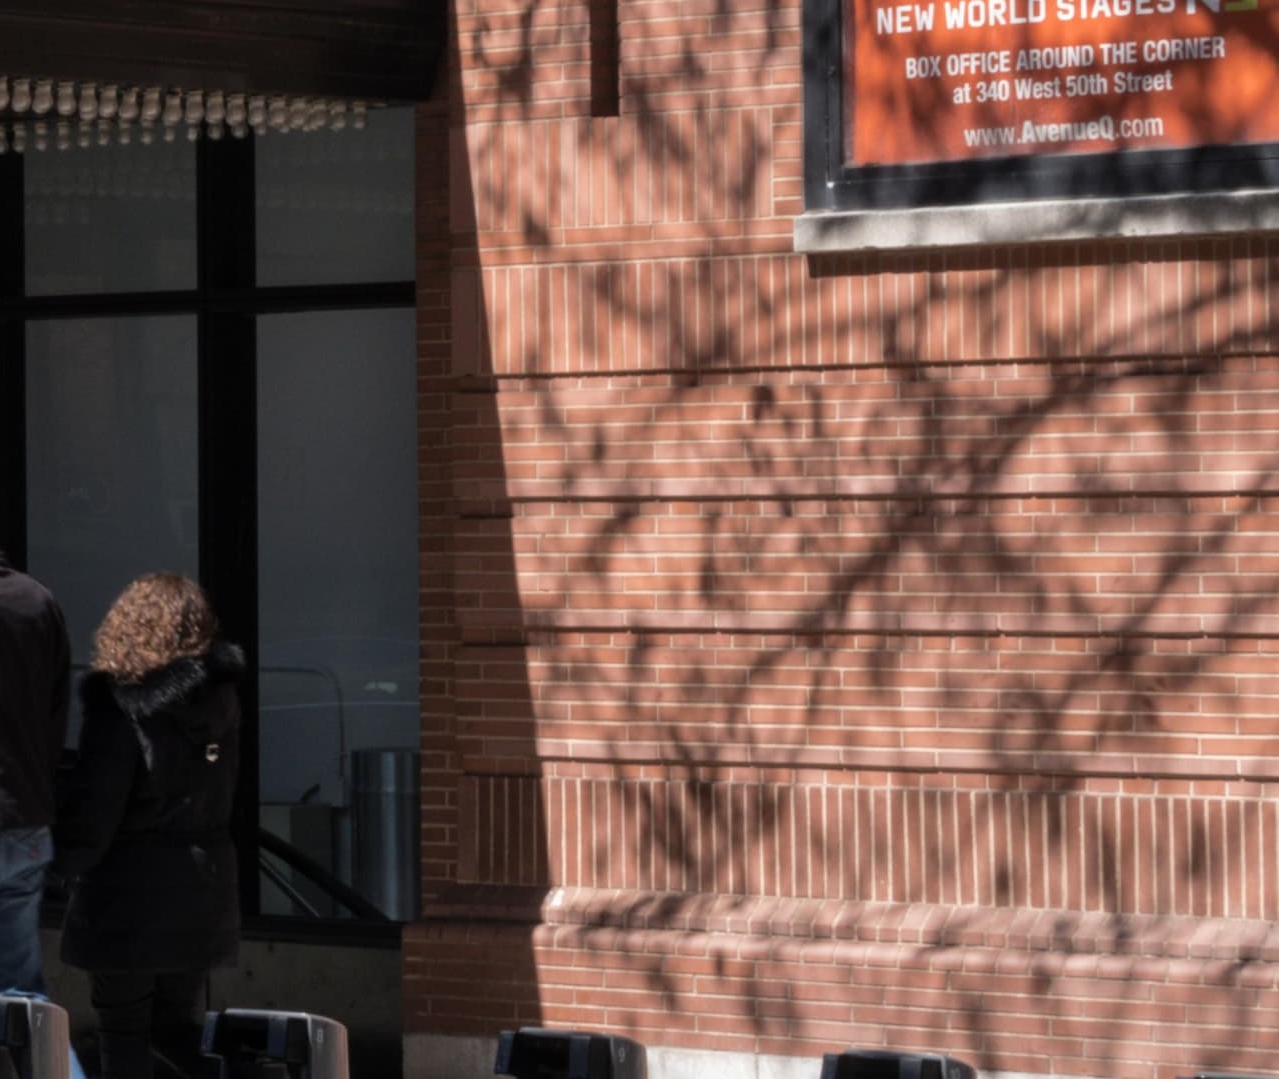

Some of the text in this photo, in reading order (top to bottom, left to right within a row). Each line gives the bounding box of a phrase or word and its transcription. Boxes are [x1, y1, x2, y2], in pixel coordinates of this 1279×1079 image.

[877, 3, 934, 35] NEW
[906, 37, 1226, 79] BOX OFFICE AROUND THE CORNER
[953, 70, 1173, 104] at 340 West 50th Street
[964, 115, 1163, 147] www.AvenueQ.com
